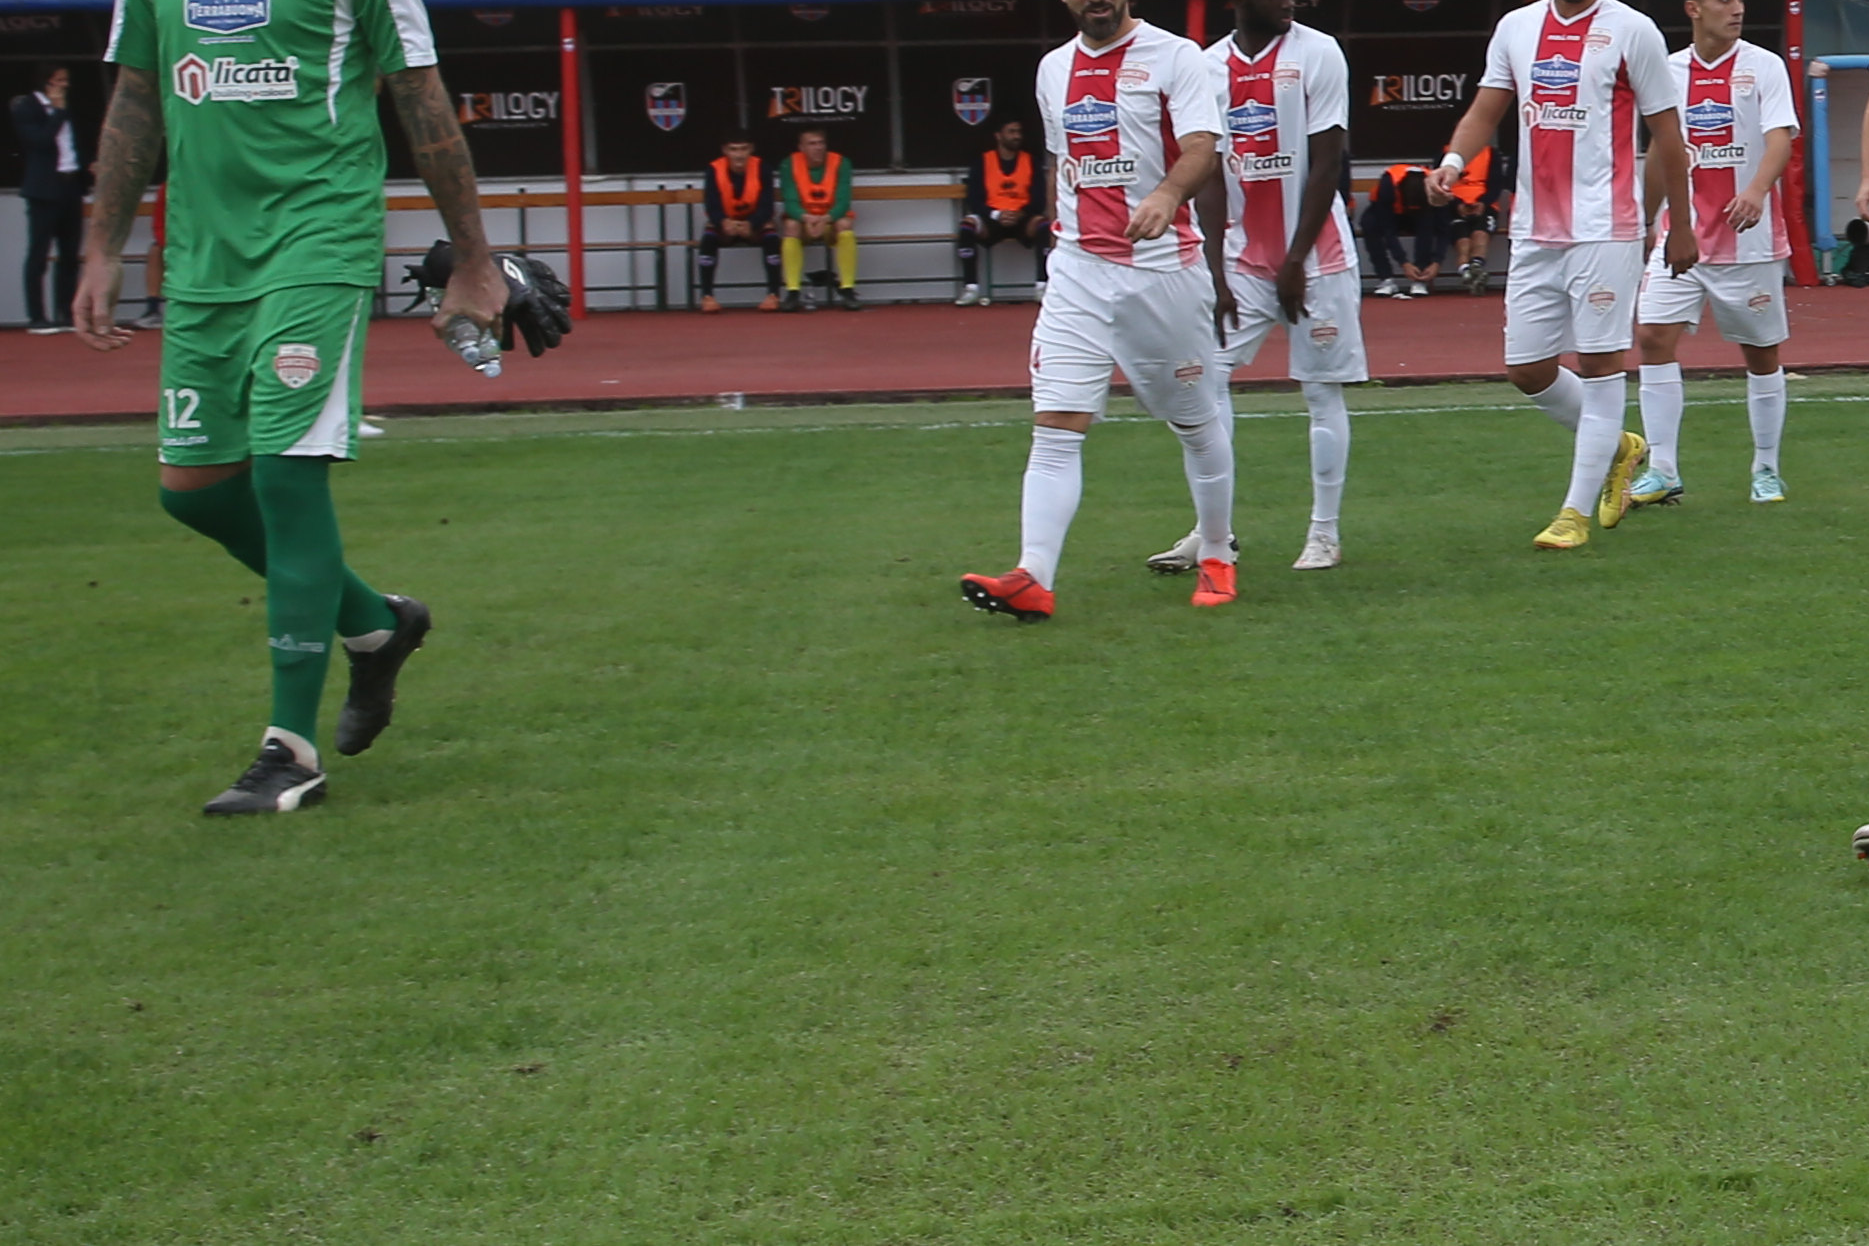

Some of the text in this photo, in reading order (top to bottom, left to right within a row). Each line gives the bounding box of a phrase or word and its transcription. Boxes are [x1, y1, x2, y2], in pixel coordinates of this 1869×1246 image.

[216, 61, 291, 84] licata
[1369, 73, 1467, 106] TRILOGY
[459, 92, 561, 125] TRILOGY
[767, 85, 869, 119] TRILOGY
[1542, 104, 1588, 121] licata
[1243, 155, 1292, 171] licata
[1701, 144, 1745, 160] licata
[1082, 160, 1136, 176] licata
[164, 388, 203, 429] 12
